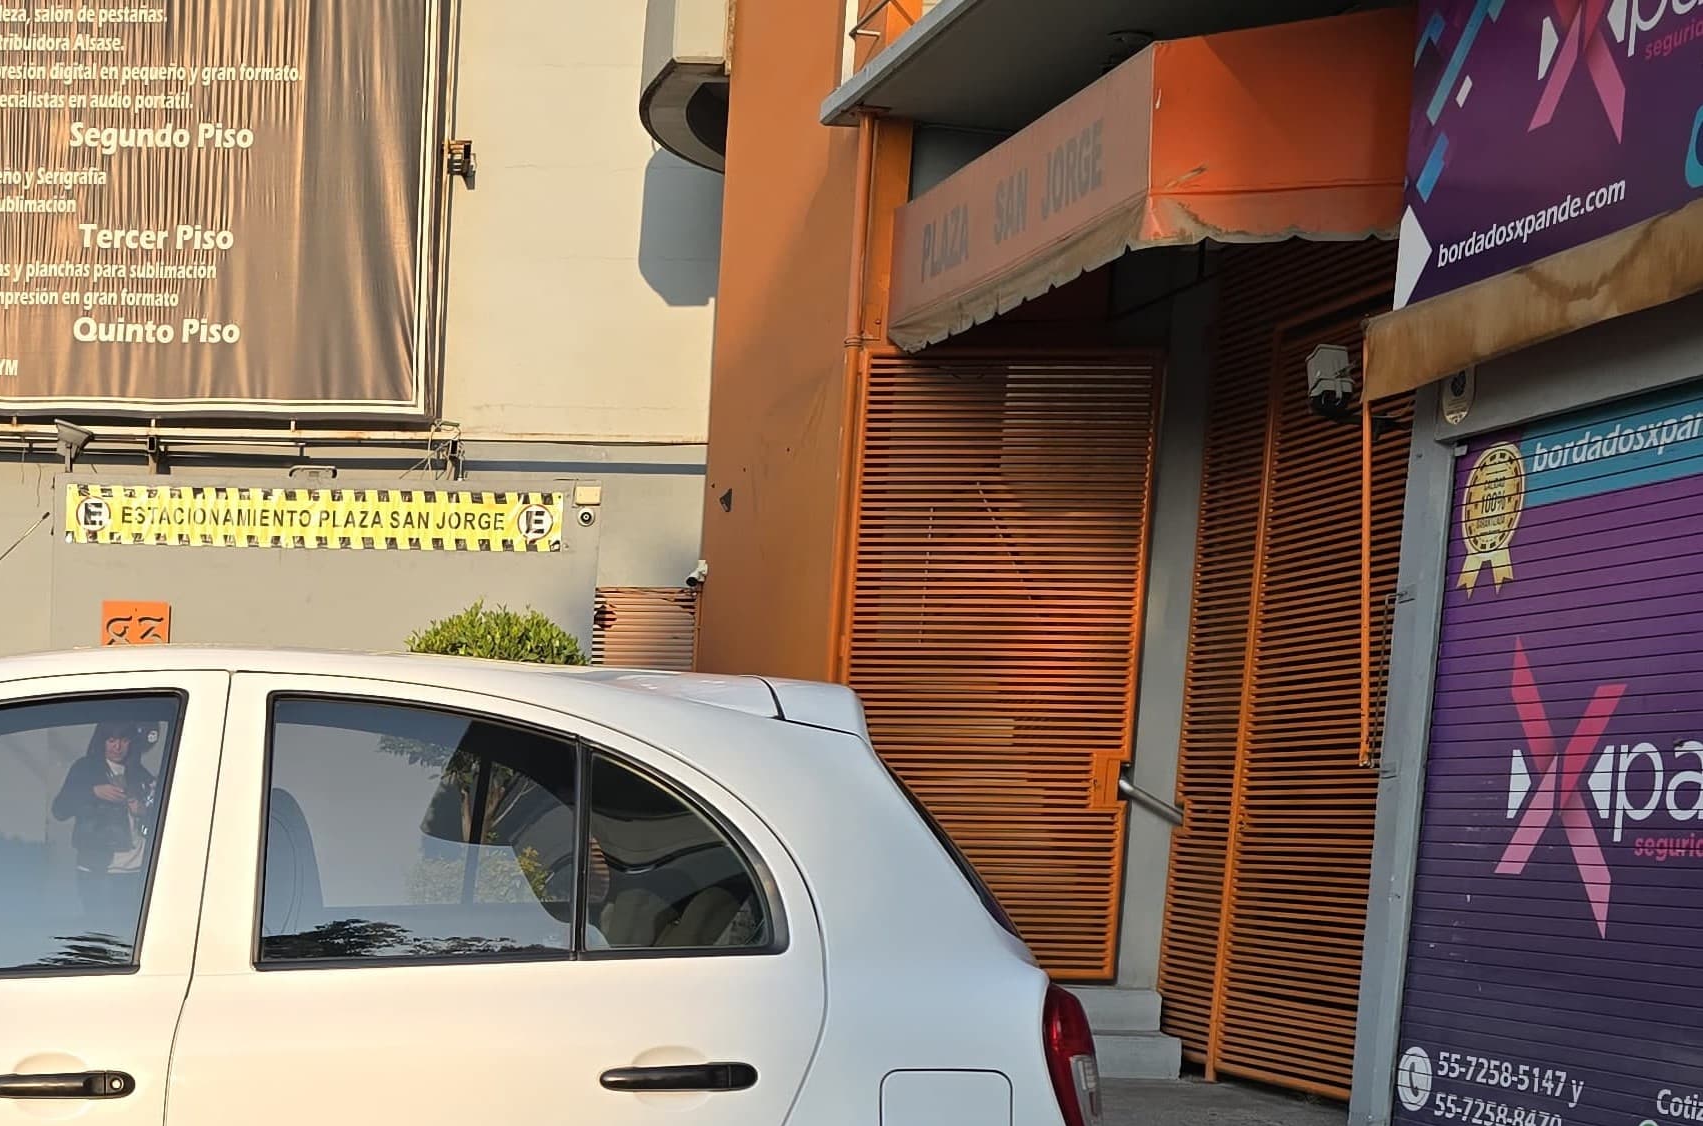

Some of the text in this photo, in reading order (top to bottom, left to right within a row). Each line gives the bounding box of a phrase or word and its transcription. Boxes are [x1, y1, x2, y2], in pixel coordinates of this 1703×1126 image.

[34, 3, 74, 23] salón
[77, 5, 96, 23] de
[98, 5, 168, 28] pestañas.
[49, 63, 97, 85] digital
[100, 65, 119, 80] en
[121, 63, 186, 86] pequeño
[188, 66, 198, 86] y
[201, 65, 236, 87] gran
[239, 64, 303, 82] formato.
[68, 93, 87, 108] en
[90, 91, 132, 109] audio
[134, 91, 194, 114] portátil.
[69, 121, 255, 155] Segundo Piso
[24, 170, 34, 190] y
[36, 166, 107, 191] Serigrafía
[920, 117, 1105, 285] PLAZA SAN JORGE
[78, 223, 235, 251] Tercer Piso
[1437, 180, 1626, 269] bordadosxpande.com
[12, 264, 23, 283] y
[25, 260, 91, 283] planchas
[93, 264, 127, 283] para
[128, 261, 217, 280] sublimación
[61, 290, 80, 305] en
[83, 289, 118, 311] gran
[120, 288, 180, 307] formato
[72, 316, 241, 345] Quinto Piso
[1481, 490, 1506, 515] 100%
[122, 506, 312, 528] ESTACIONAMIENTO
[319, 510, 384, 529] PLAZA
[389, 510, 430, 529] SAN
[436, 511, 506, 531] JORGE
[1437, 1051, 1585, 1109] 55-7258-5147 y
